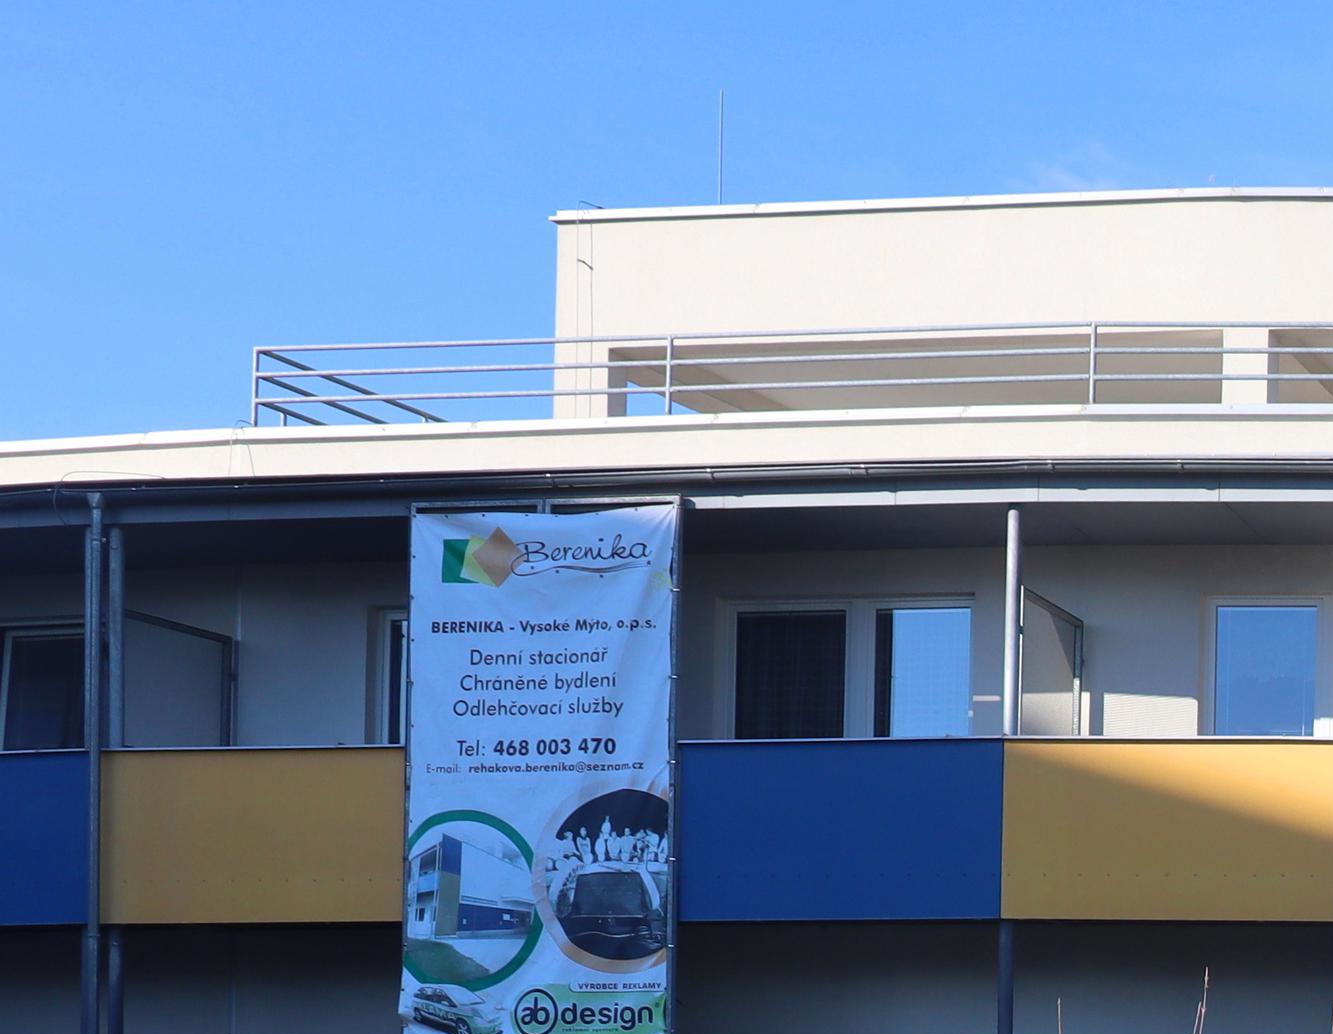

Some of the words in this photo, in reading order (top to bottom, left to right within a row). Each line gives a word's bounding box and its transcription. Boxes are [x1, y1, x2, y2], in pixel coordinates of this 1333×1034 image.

[512, 534, 652, 569] Berenika
[432, 621, 504, 633] BERENIKA
[520, 620, 569, 635] Vysoké
[576, 618, 611, 632] Mýto,
[617, 619, 656, 631] o.p.s.
[470, 649, 522, 665] Denní
[529, 647, 608, 664] stacionář
[460, 673, 547, 692] Chráněné
[555, 672, 616, 692] bydlení
[453, 699, 561, 717] Odlehčovací
[568, 697, 623, 717] služby
[457, 741, 484, 756] Tel:
[494, 739, 529, 755] 468
[537, 739, 571, 754] 003
[578, 738, 616, 754] 470
[426, 764, 460, 774] E-mail:
[469, 761, 644, 773] rehakova.berenika@seznam.cz
[623, 982, 661, 990] REKLAMY
[521, 997, 550, 1025] ab
[561, 1002, 653, 1030] design
